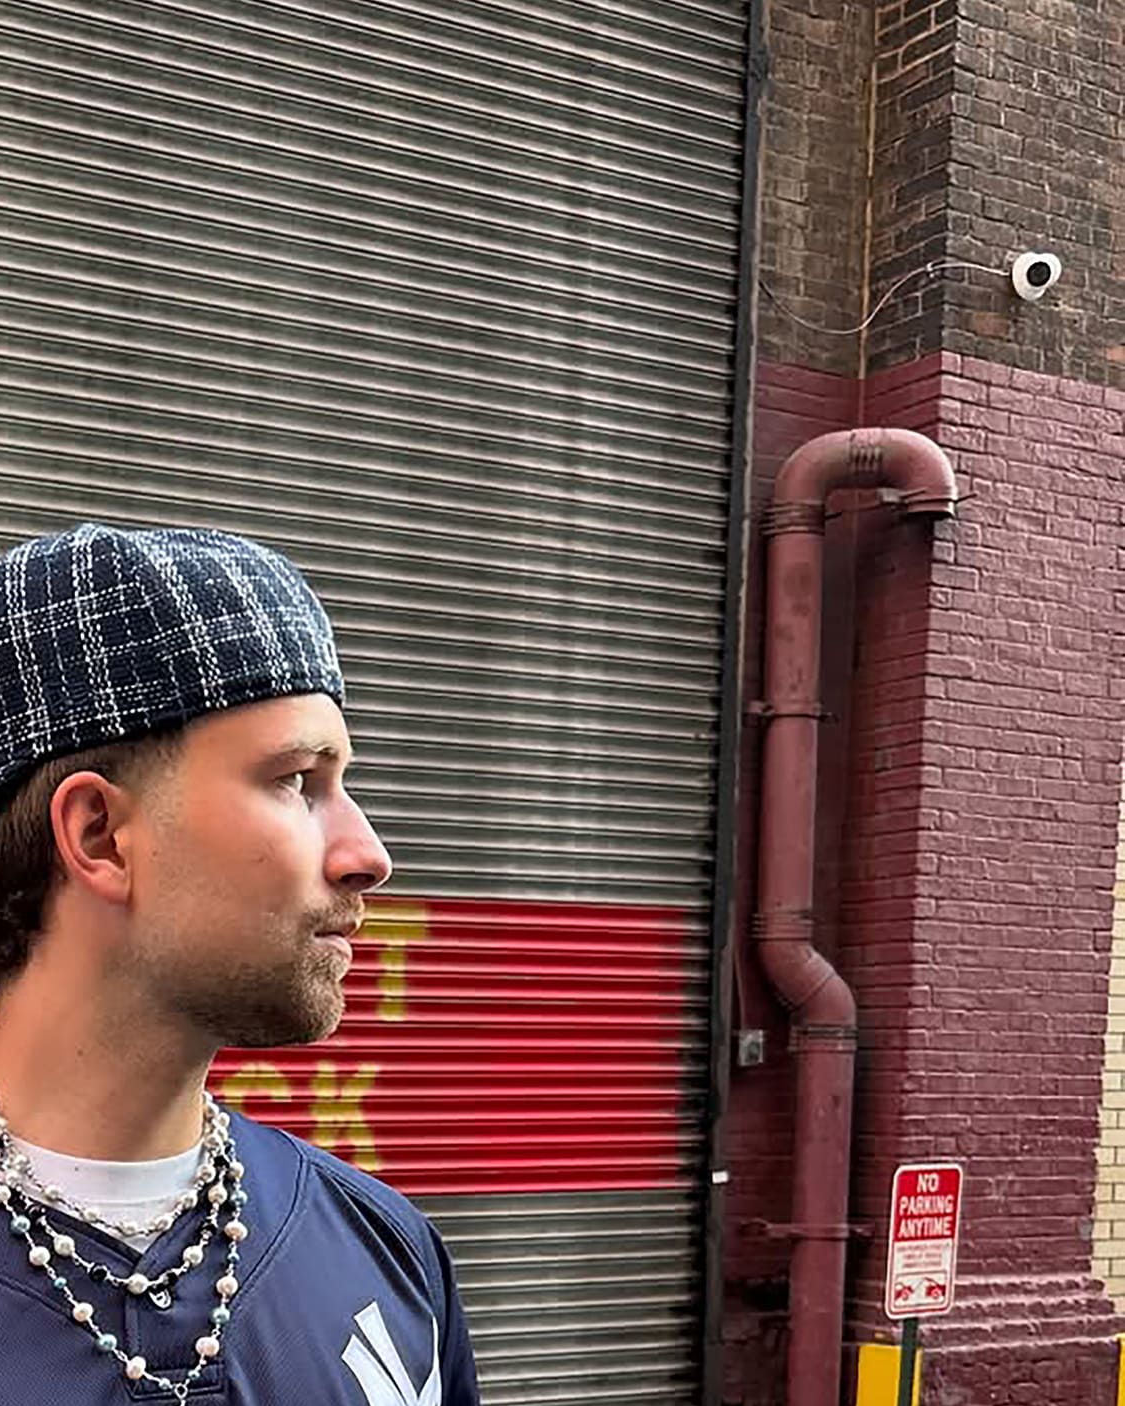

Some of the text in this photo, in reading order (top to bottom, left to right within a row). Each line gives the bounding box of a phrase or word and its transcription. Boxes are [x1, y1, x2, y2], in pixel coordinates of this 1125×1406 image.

[917, 1173, 940, 1193] NO
[899, 1194, 954, 1216] PARKING
[898, 1217, 952, 1238] ANYTIME
